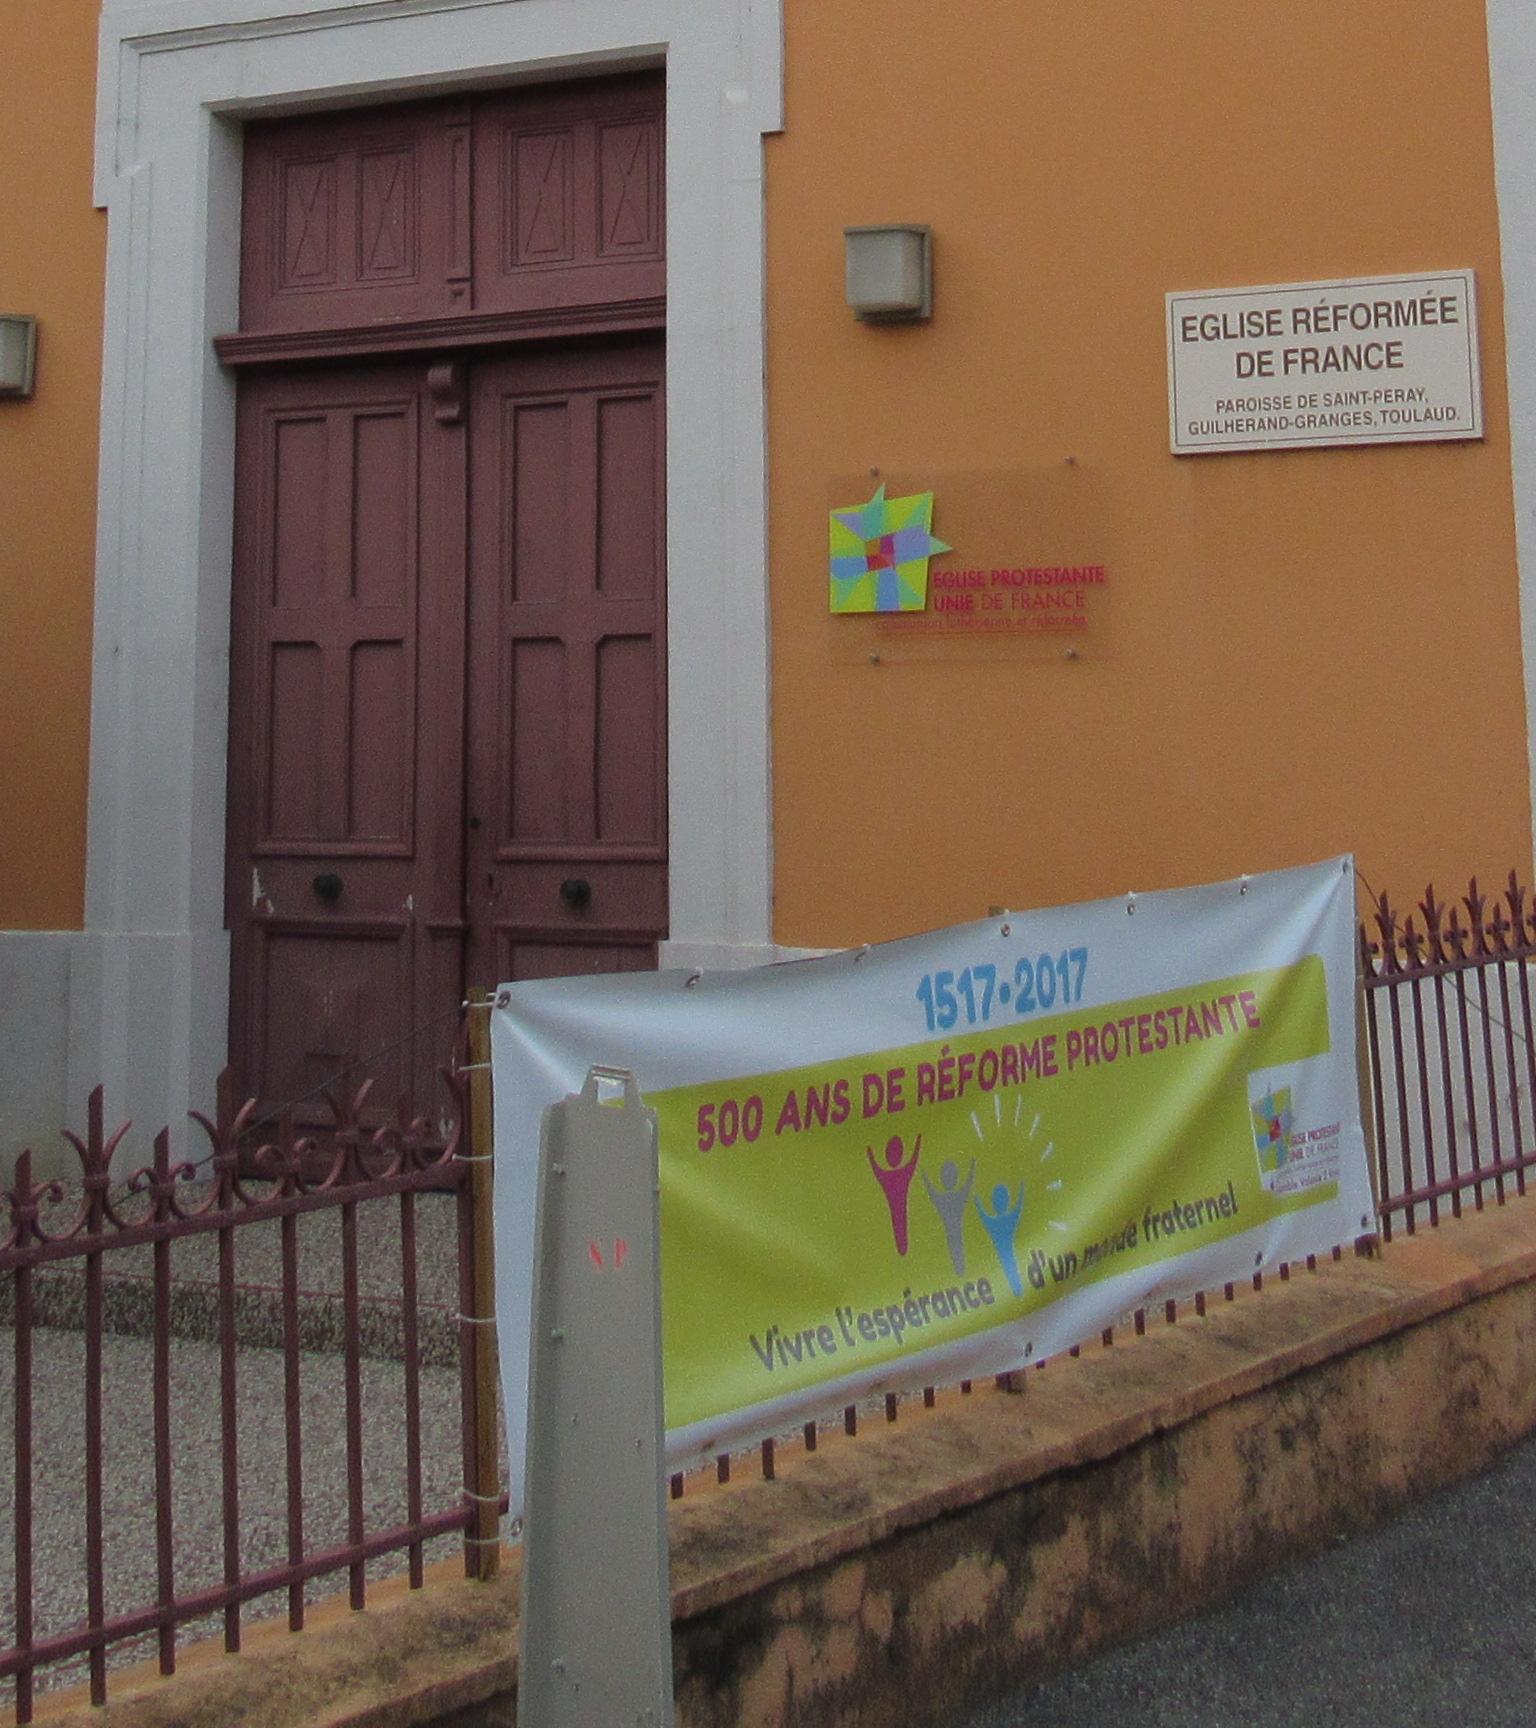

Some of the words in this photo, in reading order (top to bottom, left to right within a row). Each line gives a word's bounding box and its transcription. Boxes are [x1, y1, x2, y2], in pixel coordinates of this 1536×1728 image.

[1181, 308, 1284, 343] EGLISE
[1292, 289, 1460, 336] RÉFORMÉE
[1235, 349, 1275, 379] DE
[1282, 340, 1405, 376] FRANCE
[1215, 394, 1293, 415] PAROISSE
[1297, 392, 1318, 409] DE
[1322, 387, 1429, 408] SAINT-PERAY,
[1187, 410, 1378, 436] GUILHERAND-GRANGES,
[1380, 405, 1461, 425] TOULAUD.
[991, 565, 1105, 588] PROTESTANTE
[933, 595, 975, 613] UNIE
[980, 593, 1004, 611] DE
[1011, 590, 1086, 610] FRANCE
[696, 1094, 764, 1152] 500
[774, 1078, 853, 1136] ANS
[861, 1067, 907, 1119] DE
[915, 1044, 1059, 1106] RÉFORME
[1066, 990, 1261, 1071] PROTESTANTE
[749, 1323, 838, 1372] Vivre
[835, 1276, 996, 1347] l'espérance
[1027, 1248, 1077, 1289] d'un
[1142, 1179, 1239, 1243] fraternel
